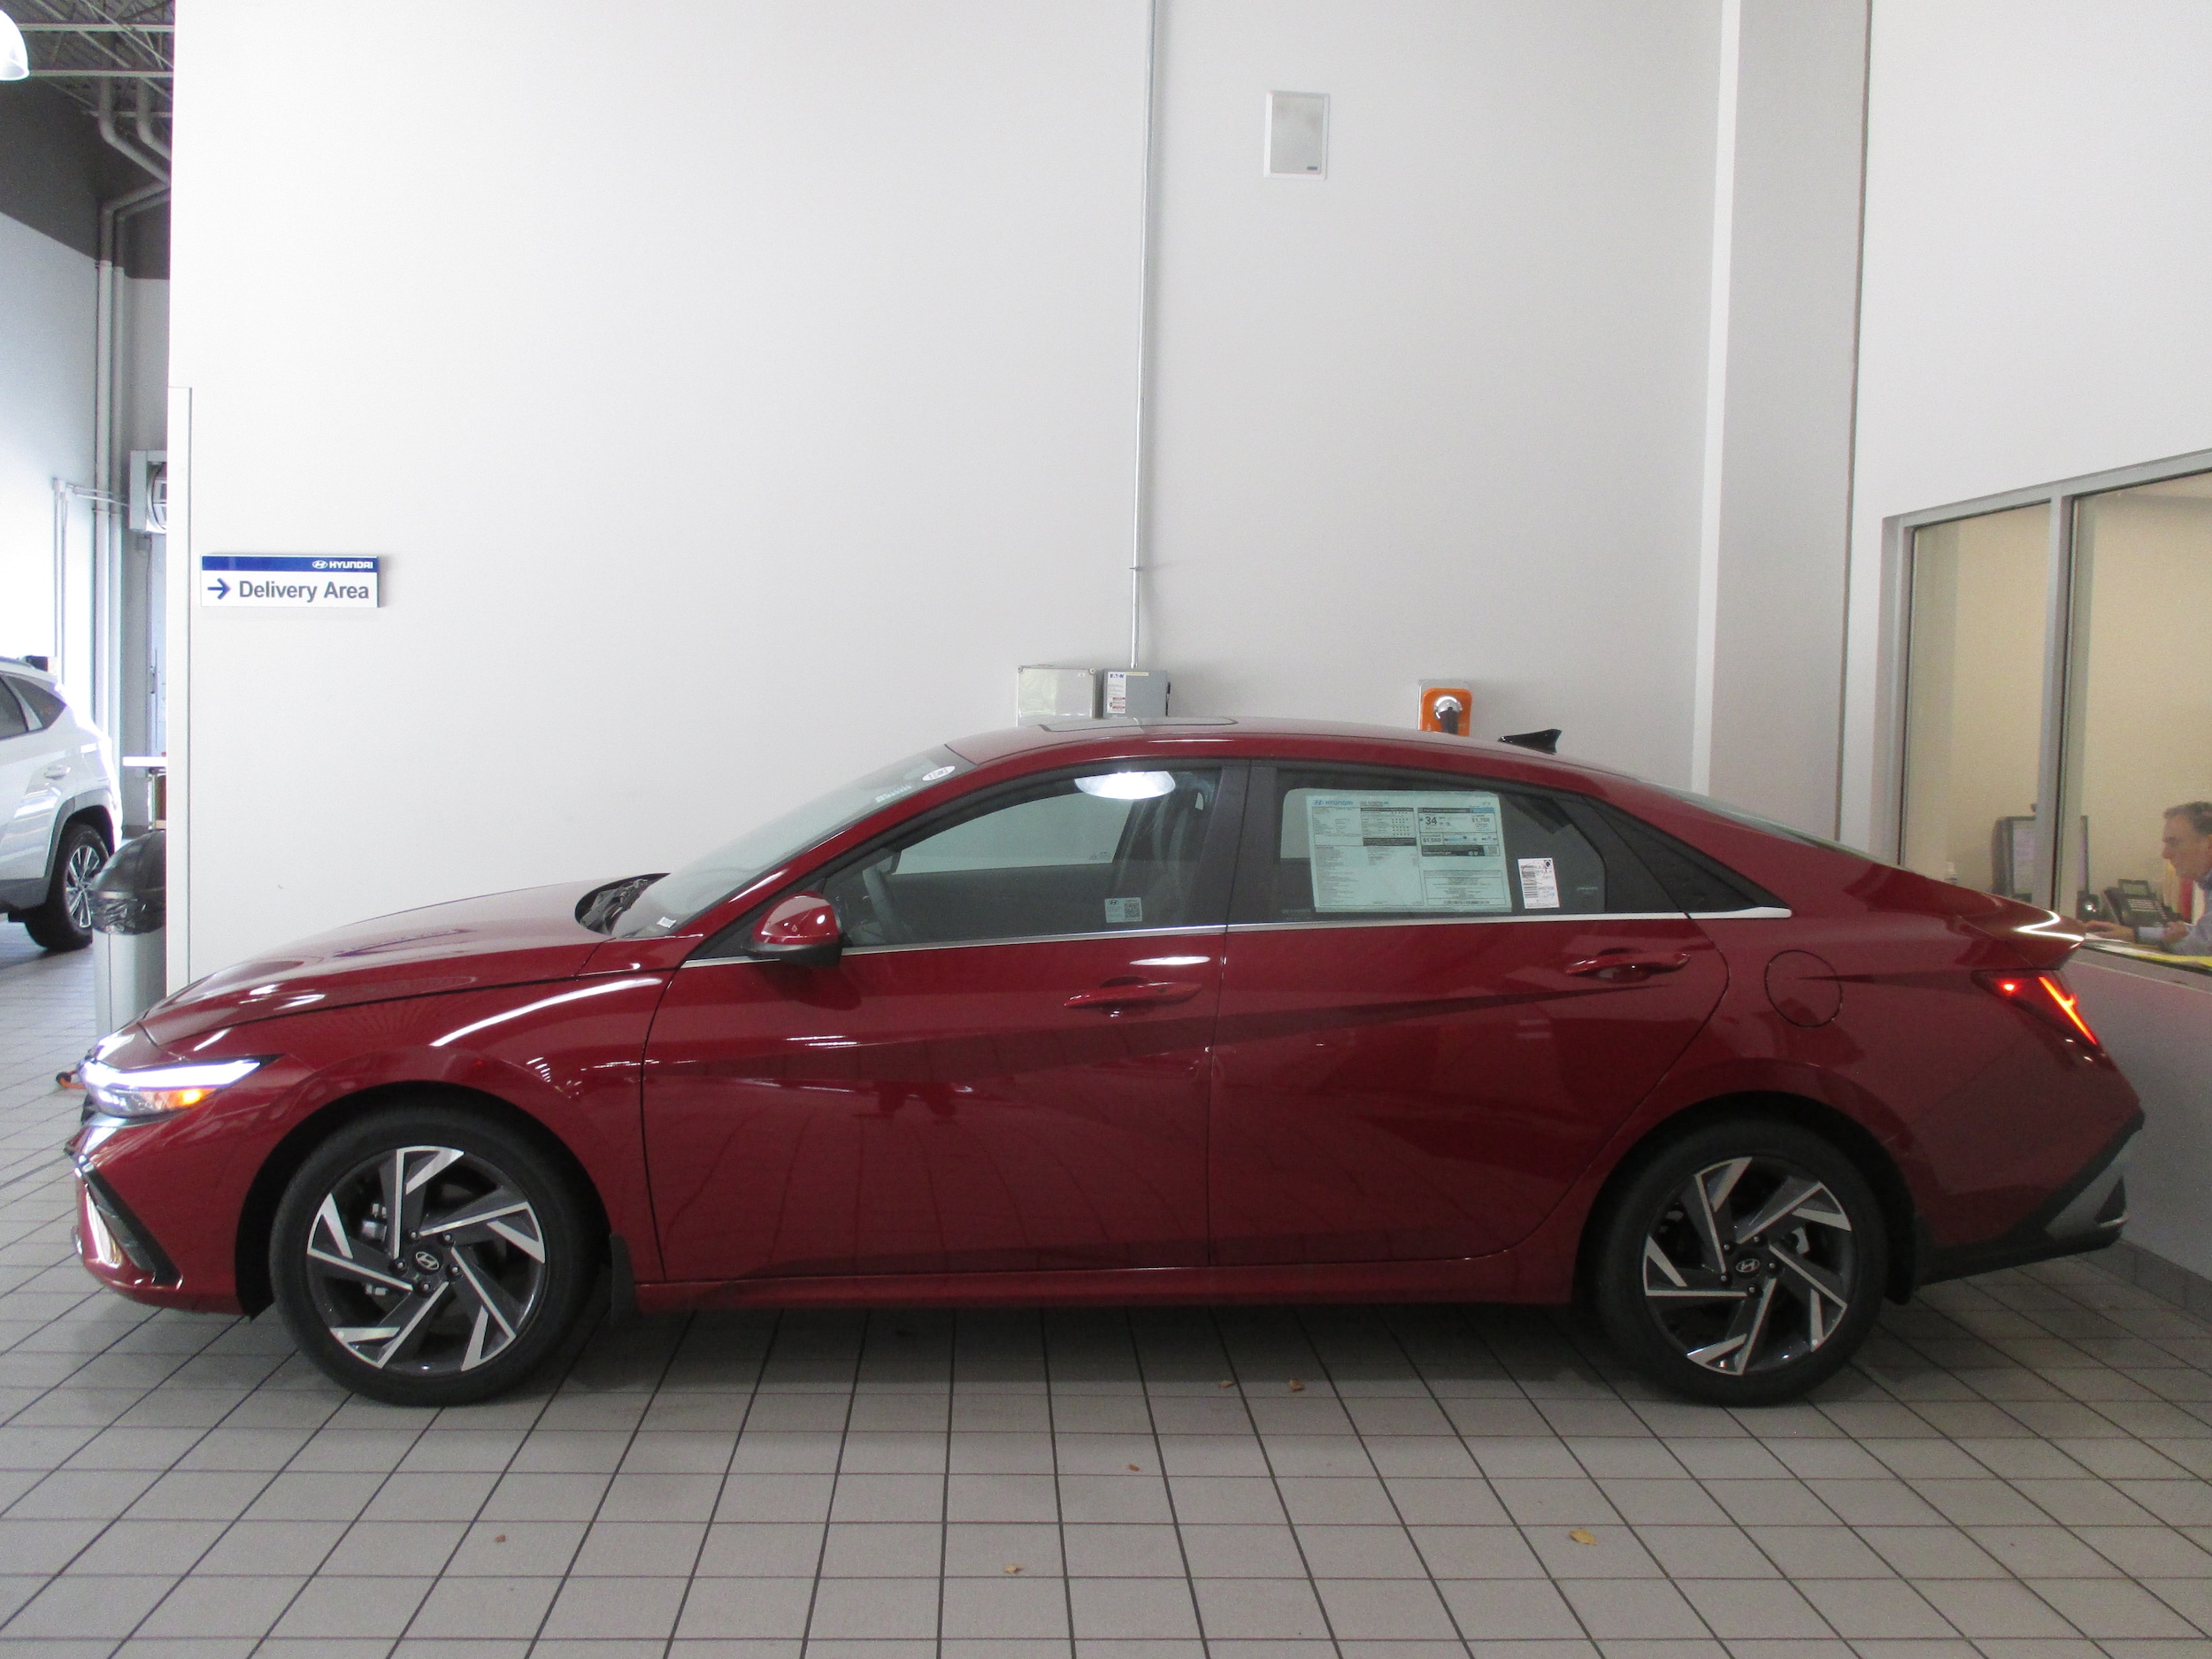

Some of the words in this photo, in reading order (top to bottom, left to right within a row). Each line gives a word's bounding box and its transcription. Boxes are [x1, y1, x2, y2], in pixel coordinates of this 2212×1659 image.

[240, 580, 318, 603] Delivery
[324, 581, 369, 599] Area
[1425, 816, 1437, 826] 34
